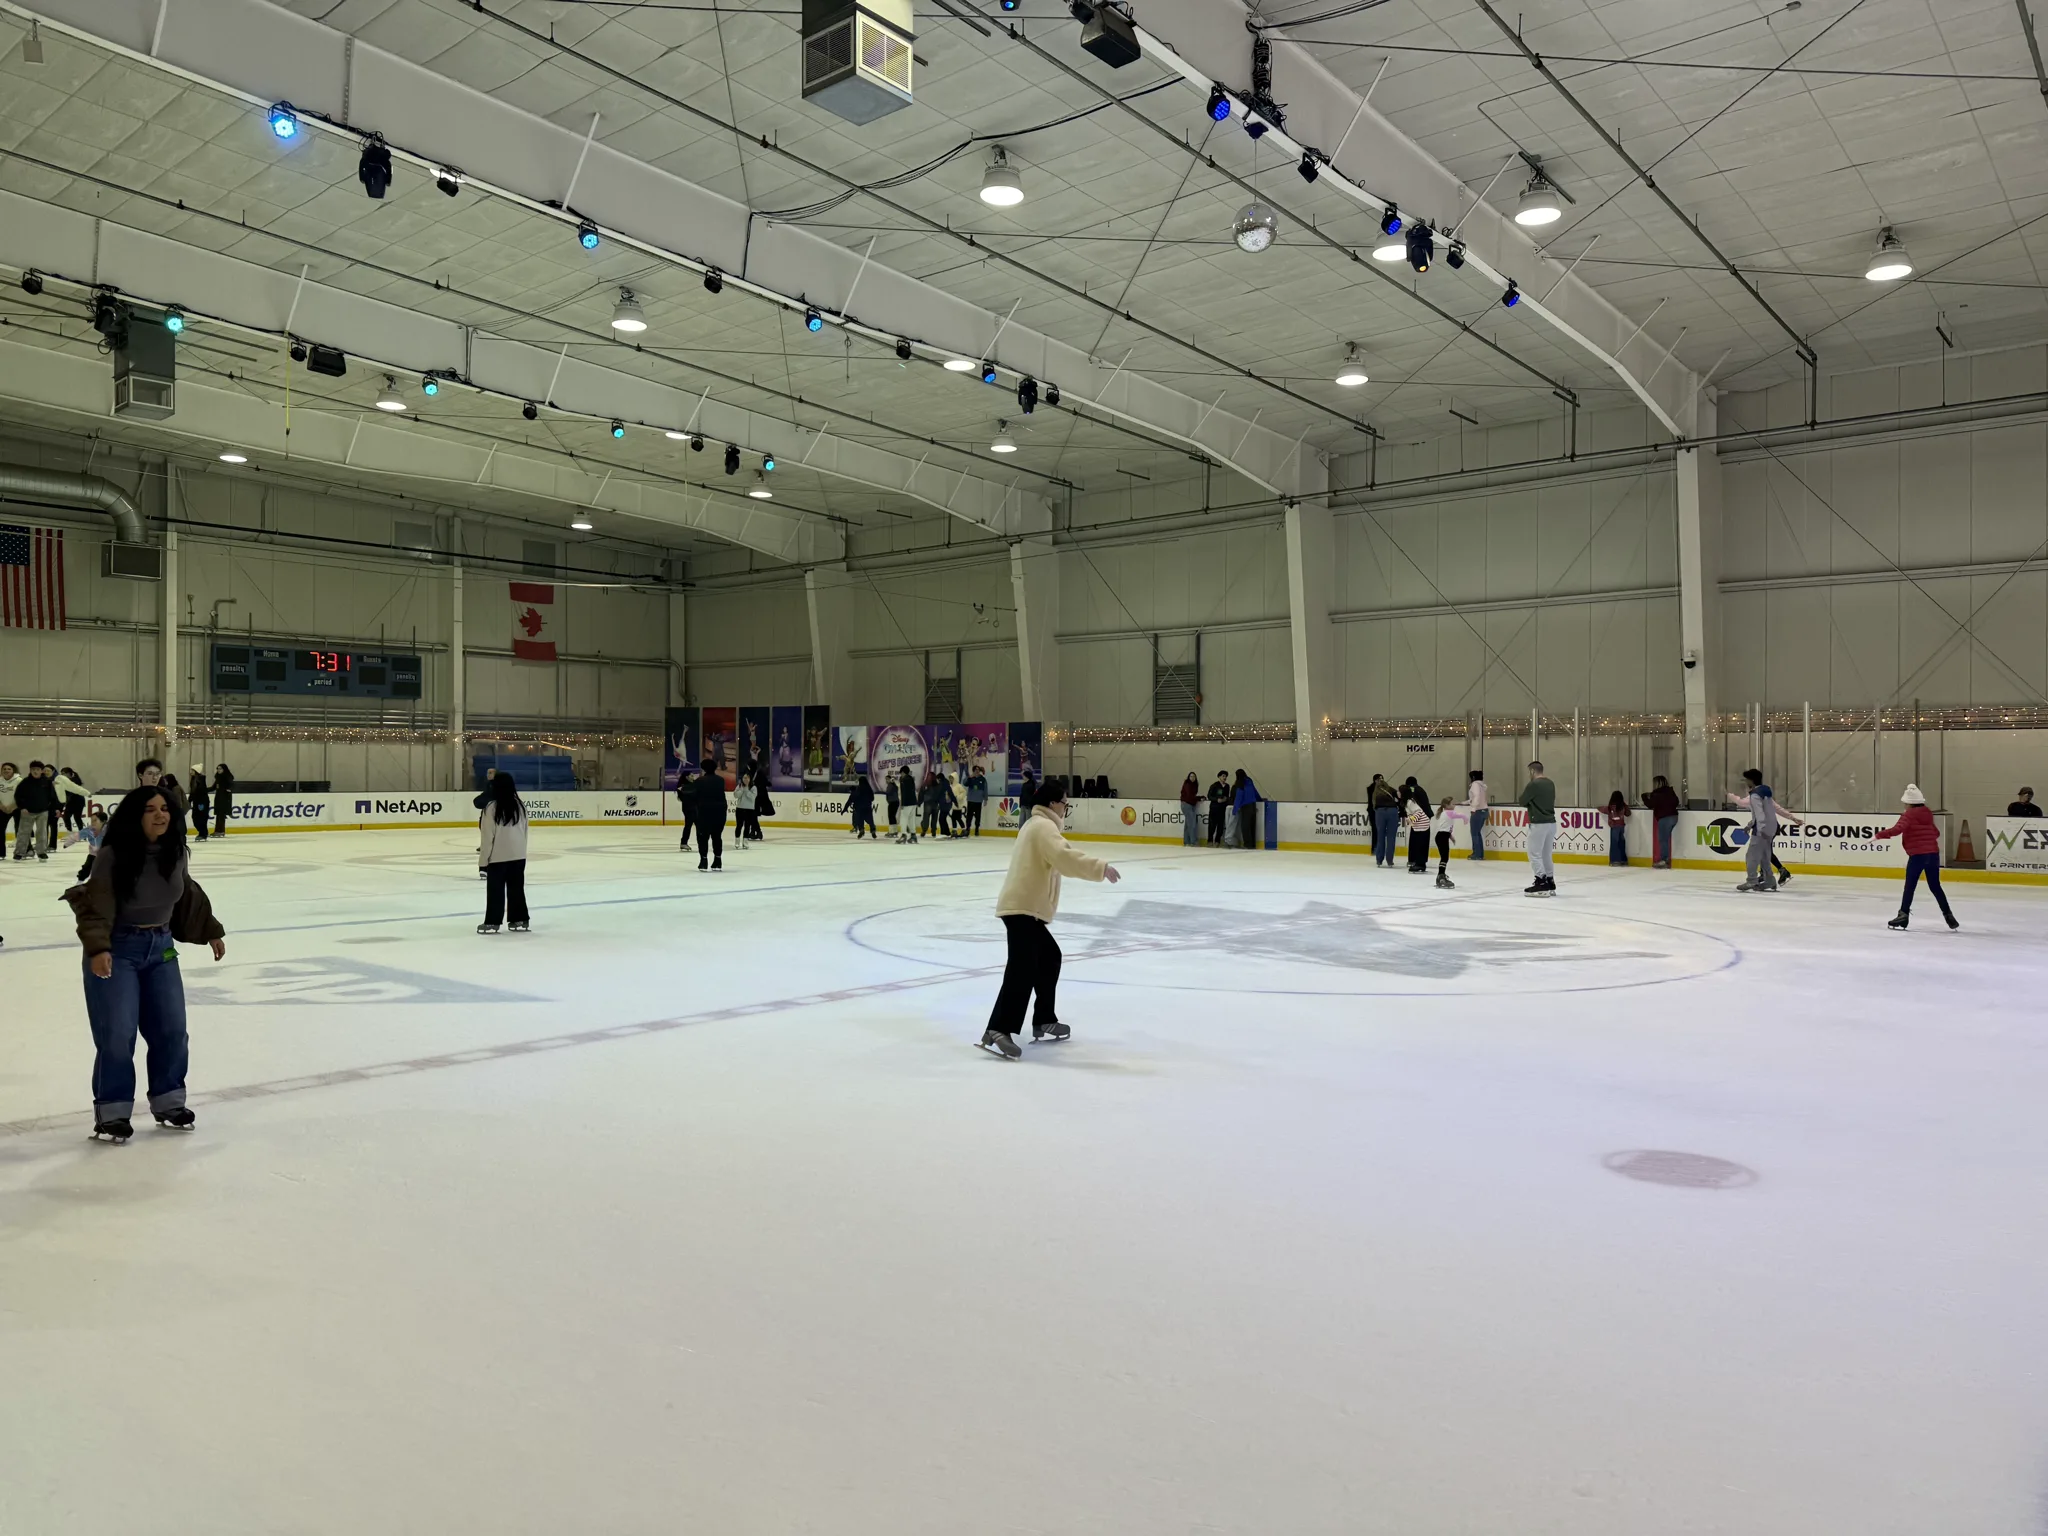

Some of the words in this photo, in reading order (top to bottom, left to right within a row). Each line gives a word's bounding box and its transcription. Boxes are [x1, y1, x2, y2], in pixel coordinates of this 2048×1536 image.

[309, 651, 351, 672] 7:31
[1406, 744, 1435, 752] HOME
[376, 800, 443, 815] NetApp
[528, 811, 581, 819] ERMANENTE
[1560, 811, 1604, 829] SOUL
[1485, 840, 1526, 849] COFFEE
[1552, 842, 1604, 851] RVEYORS
[1839, 841, 1891, 852] Rooter
